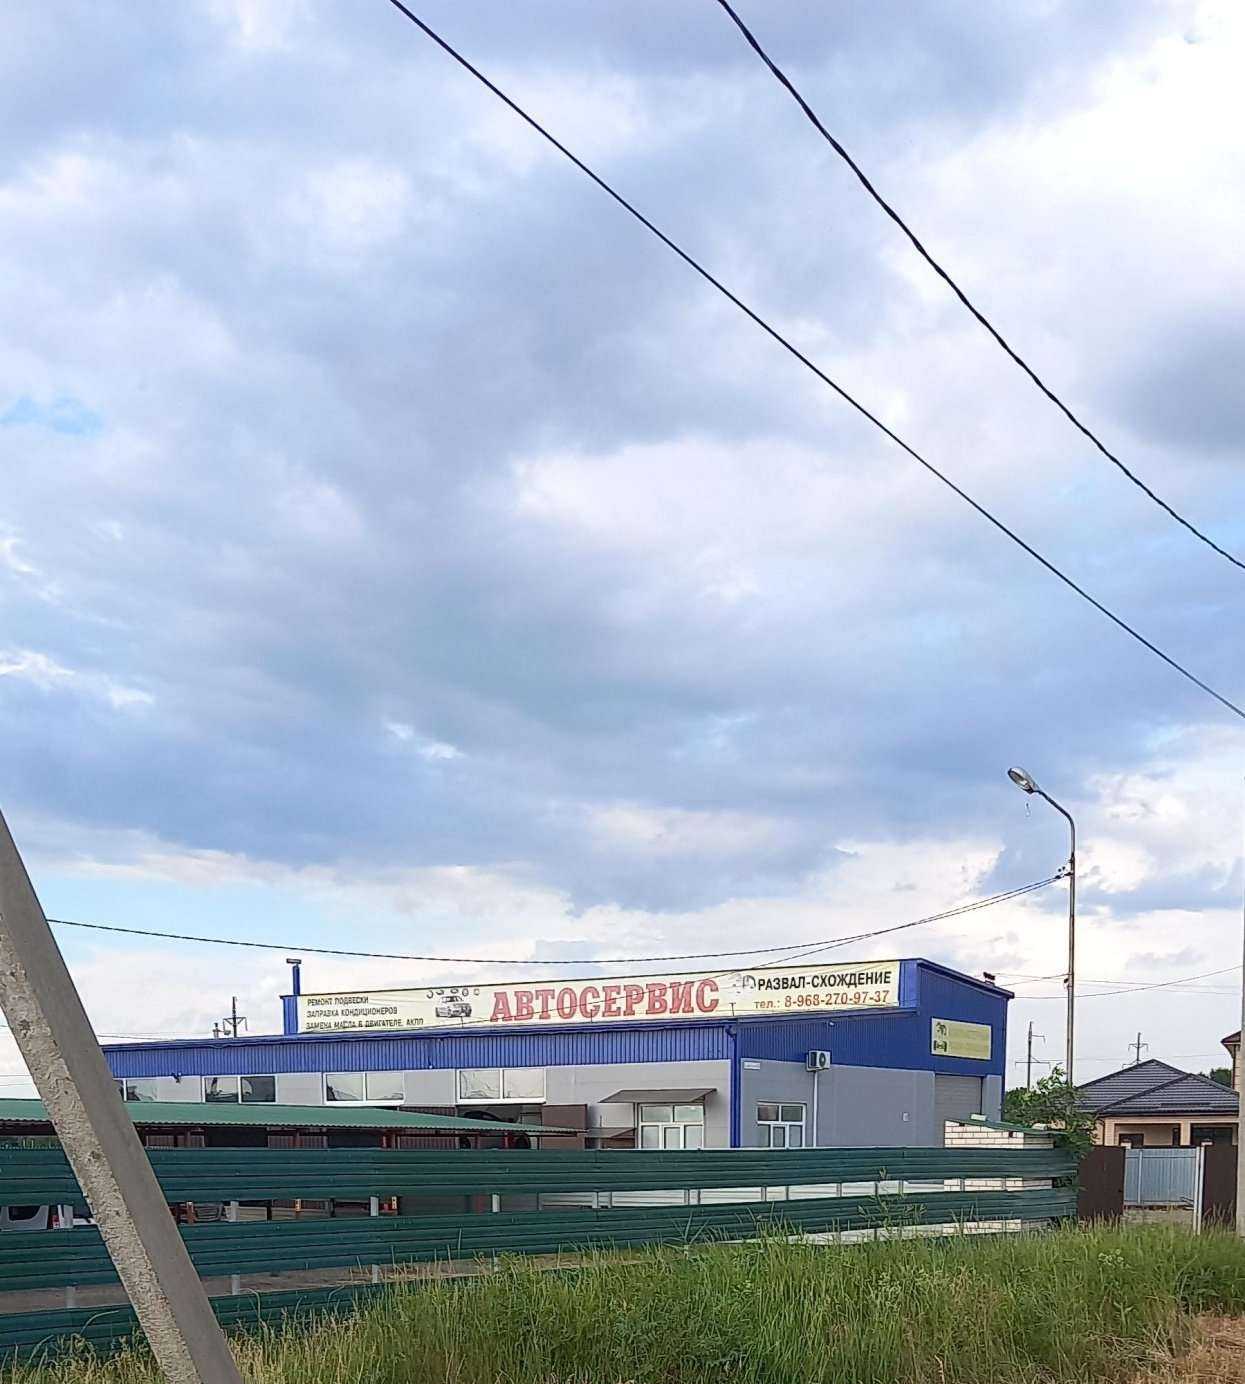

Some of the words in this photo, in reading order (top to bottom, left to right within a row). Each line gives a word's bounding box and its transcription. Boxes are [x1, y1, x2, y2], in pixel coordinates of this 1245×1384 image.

[758, 971, 892, 991] РАЗВАЛ-СХОЖДЕНИЕ
[307, 998, 333, 1006] РЕМОНТ
[335, 996, 369, 1005] ПОДВЕСКИ
[490, 979, 720, 1022] АВТОСЕРВИС
[754, 999, 780, 1009] тел.:
[784, 990, 890, 1008] 8-968-270-97-37
[306, 1009, 339, 1018] ЗАПРАВКА
[341, 1007, 398, 1016] КОНДИЦИОНЕРОВ
[306, 1021, 332, 1029] ЗАМЕНА
[334, 1020, 357, 1028] МАСЛА
